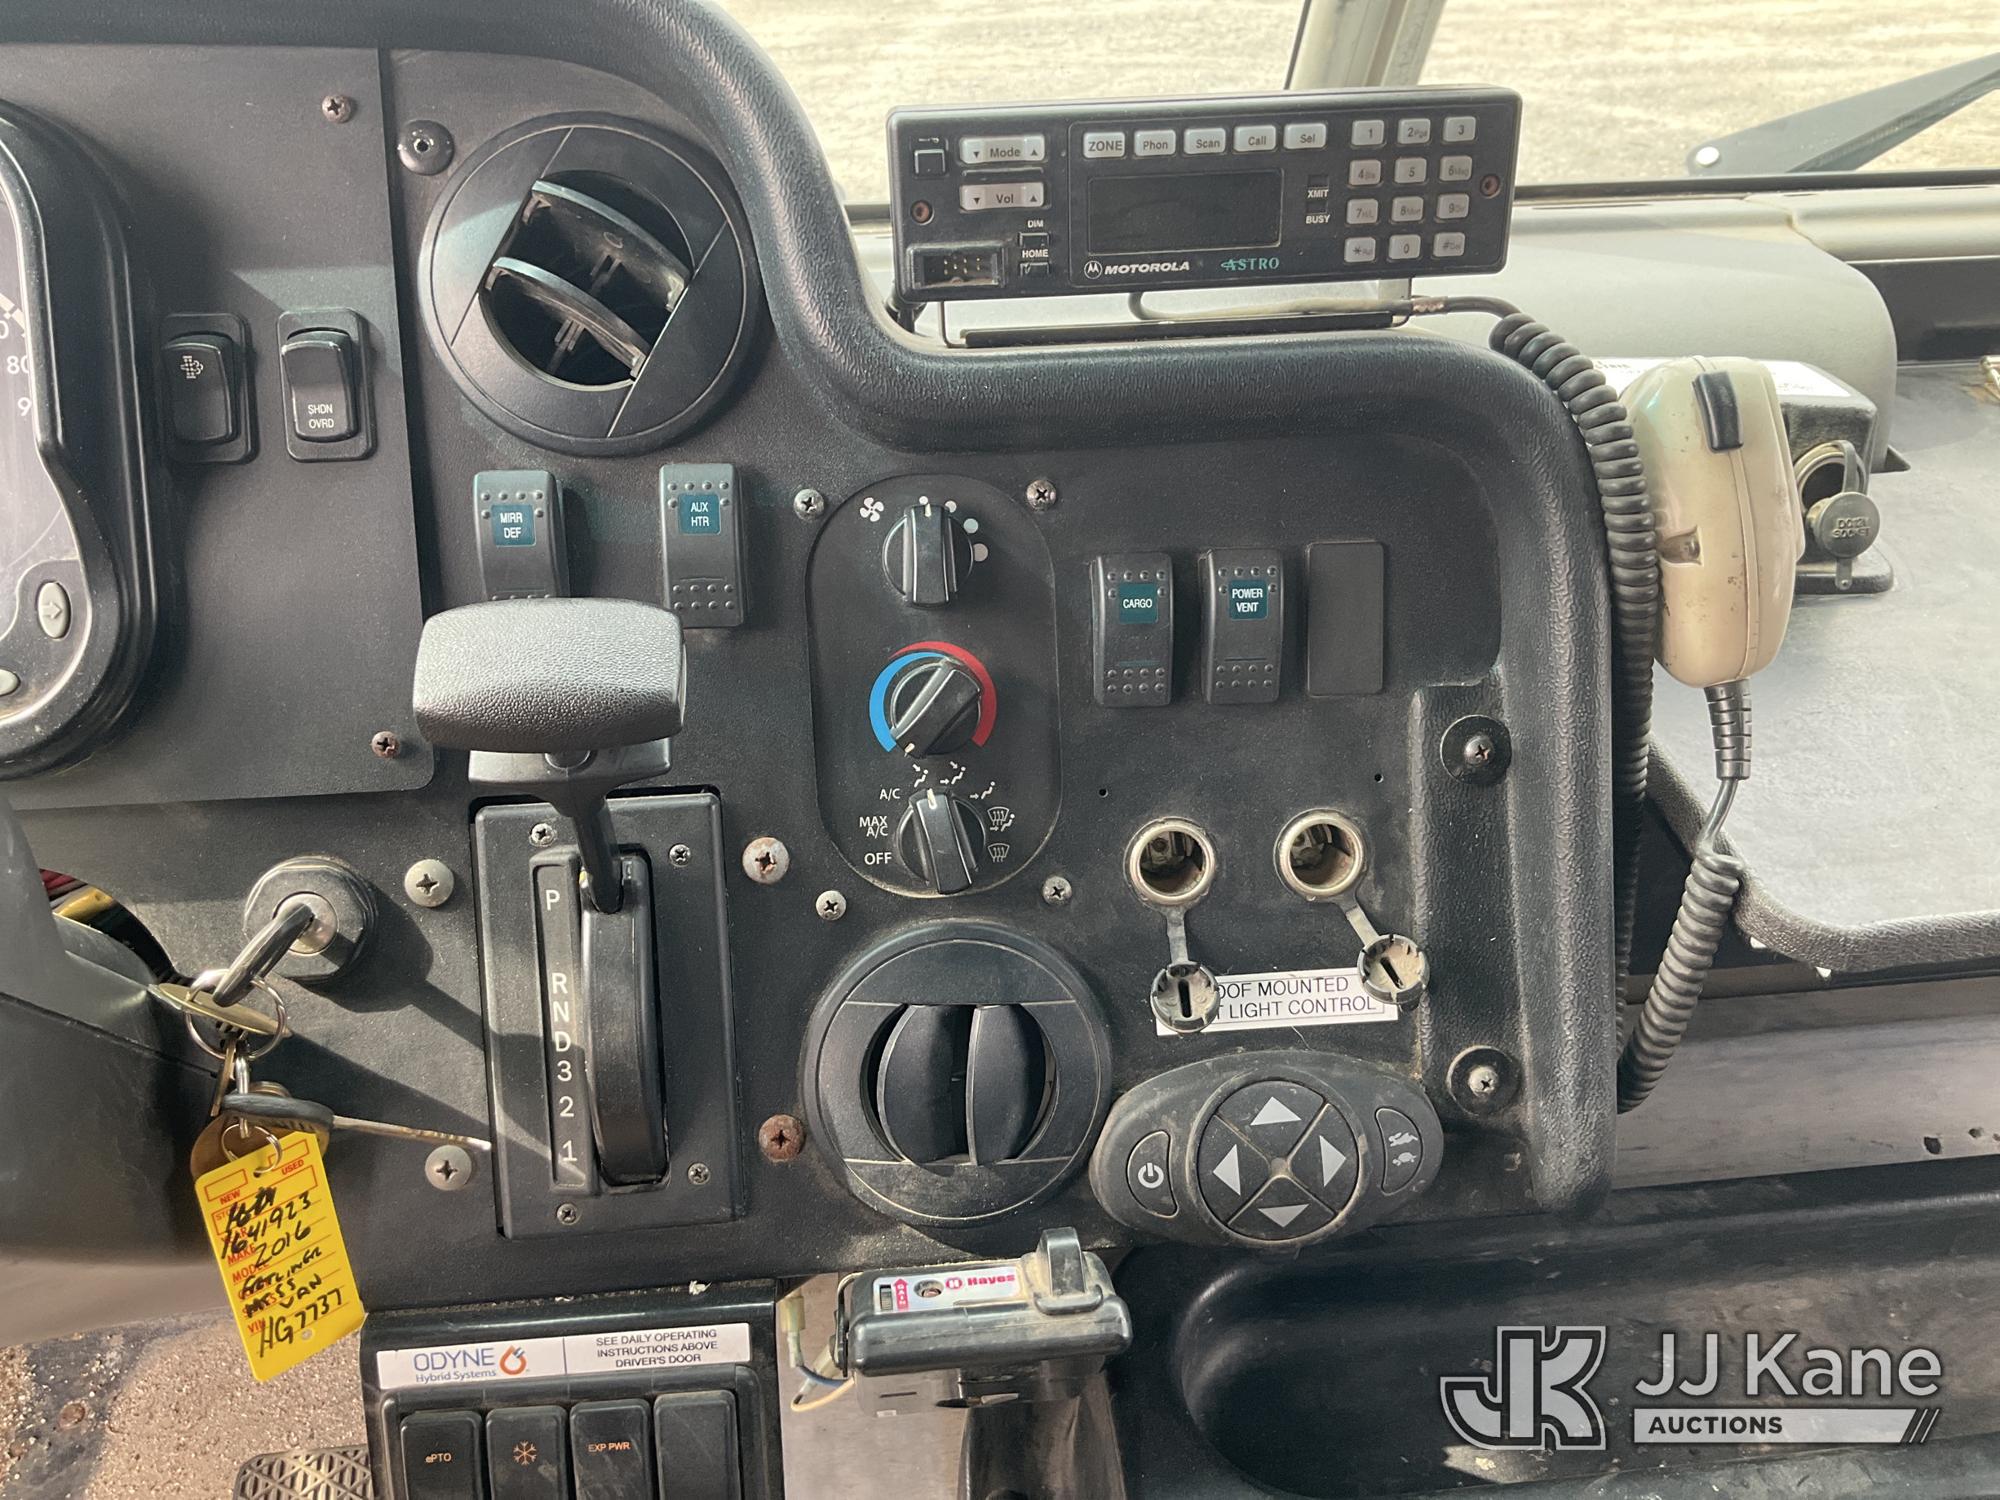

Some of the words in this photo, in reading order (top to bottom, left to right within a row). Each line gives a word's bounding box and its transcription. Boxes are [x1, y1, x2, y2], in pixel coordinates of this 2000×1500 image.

[1368, 128, 1373, 138] 1
[1458, 124, 1464, 135] 3
[1196, 139, 1220, 149] Scan
[1248, 136, 1267, 146] Call
[1300, 133, 1316, 143] Sel
[1088, 140, 1123, 152] ZONE
[1143, 140, 1168, 150] Phon
[990, 146, 1021, 158] Mode
[1409, 167, 1415, 177] 5
[996, 193, 1014, 204] Vol
[1307, 189, 1329, 198] XMIT
[1027, 219, 1044, 228] DIM
[1305, 214, 1331, 224] BUSY
[1022, 249, 1049, 259] HOME
[1403, 243, 1409, 254] 0
[1104, 260, 1190, 275] MOTOROLA
[1220, 257, 1280, 272] ASTRO
[307, 404, 333, 414] SHDN
[308, 418, 335, 429] OVRD
[690, 502, 709, 512] AUX
[500, 512, 523, 523] MIRR
[691, 516, 709, 527] HTR
[503, 528, 522, 538] DEF
[1232, 588, 1263, 599] POWER
[1122, 598, 1153, 609] CARGO
[1236, 602, 1259, 613] VENT
[879, 788, 901, 801] A/C
[859, 816, 888, 827] MAX
[866, 825, 889, 839] A/C
[864, 852, 893, 865] OFF
[545, 889, 561, 911] P
[552, 972, 568, 994] R
[1258, 977, 1349, 996] MOUNTED
[552, 1001, 570, 1023] N
[1230, 1001, 1283, 1019] LIGHT
[1288, 995, 1377, 1014] CONTROL
[555, 1031, 571, 1052] D
[557, 1060, 573, 1082] 3
[559, 1095, 575, 1117] 2
[562, 1139, 578, 1162] 1
[281, 1159, 304, 1175] USED
[220, 1189, 241, 1204] NEW
[255, 1220, 311, 1269] 2016
[967, 1274, 1015, 1286] Hayes
[596, 1336, 618, 1346] SEE
[620, 1334, 652, 1344] DAILY
[654, 1329, 717, 1342] OPERATING
[597, 1344, 678, 1358] INSTRUCTIONS
[680, 1341, 718, 1351] ABOVE
[413, 1347, 495, 1372] ODYNE
[615, 1356, 666, 1368] DRIVER'S
[668, 1353, 702, 1364] DOOR
[415, 1370, 451, 1384] Hybrid
[454, 1368, 497, 1381] Systems
[588, 1443, 607, 1453] EXP
[608, 1441, 631, 1451] PWR
[425, 1452, 452, 1464] ePTO
